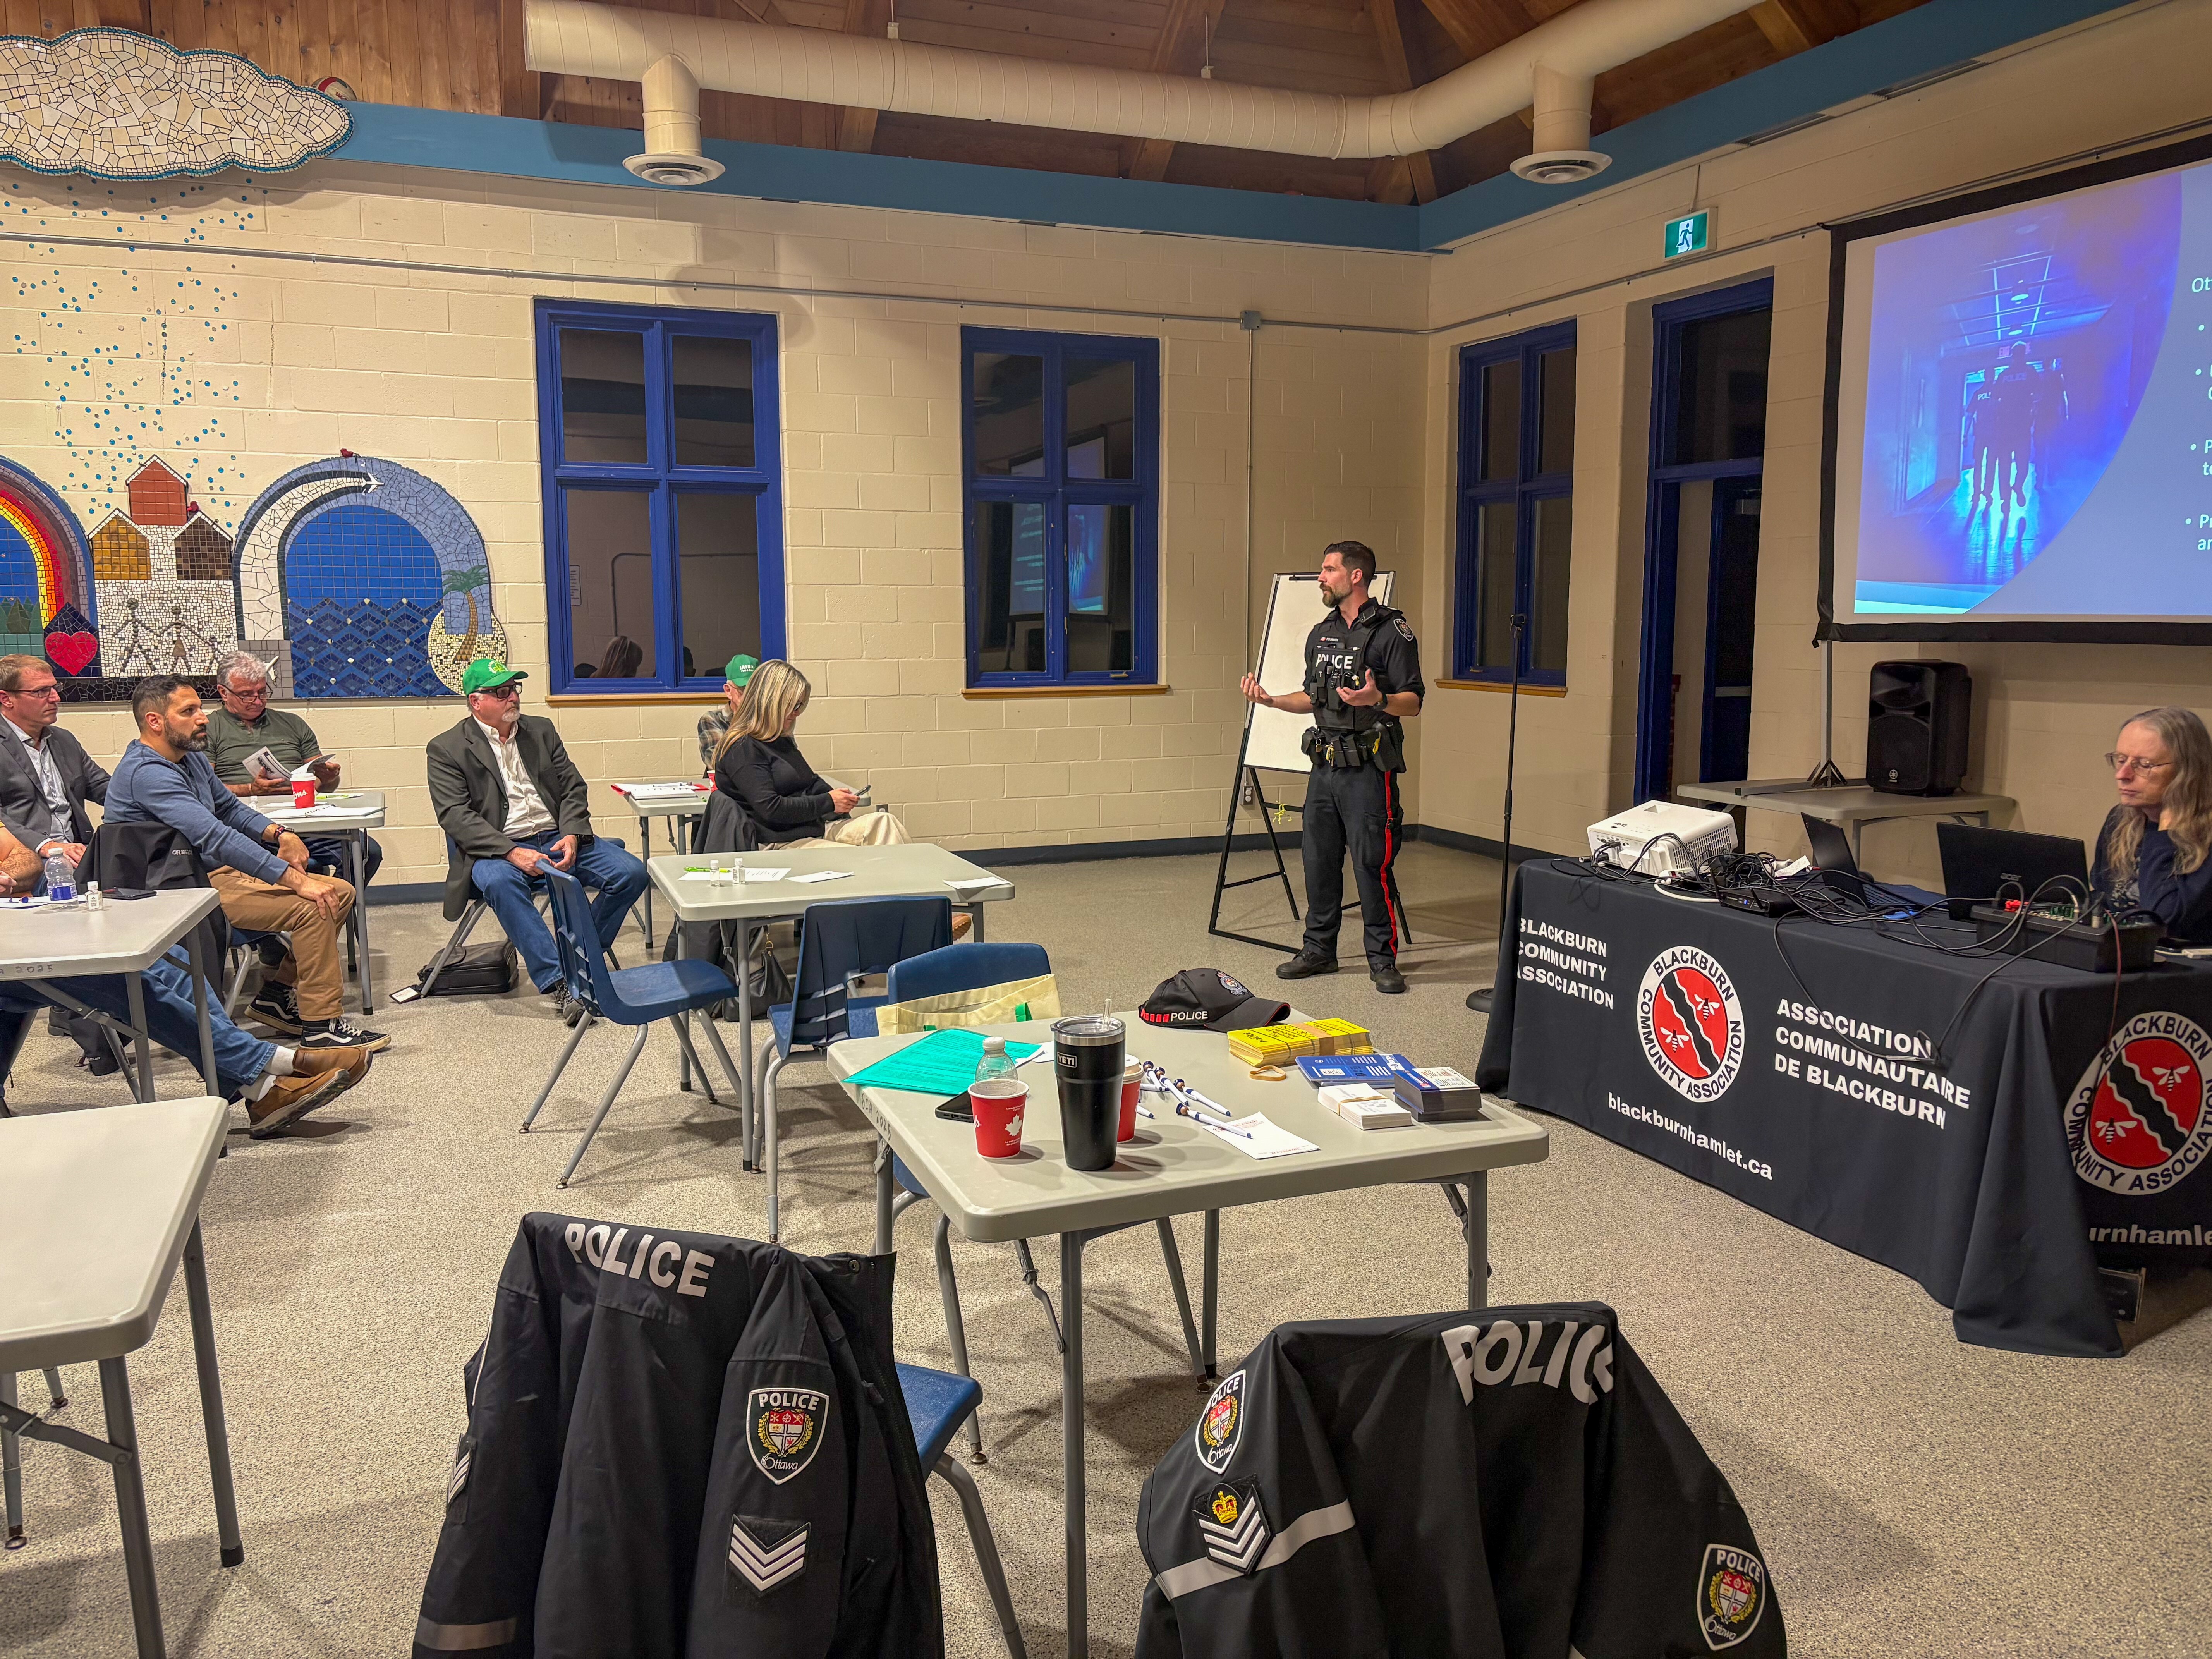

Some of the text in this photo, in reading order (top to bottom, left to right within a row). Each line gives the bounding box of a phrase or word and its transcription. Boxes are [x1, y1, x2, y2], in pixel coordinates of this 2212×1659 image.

[1653, 948, 1735, 1002] BLACKBURN
[1170, 1011, 1208, 1022] POLICE
[1640, 988, 1686, 1089] COMMUNITY
[1777, 998, 1932, 1059] ASSOCIATION
[2100, 1015, 2212, 1066] BLACKBURN
[1058, 1054, 1075, 1065] YETI
[1686, 1020, 1742, 1099] ASSOCIATION
[1775, 1026, 1971, 1109] COMMUNAUTAIRE
[1774, 1053, 1946, 1130] DE BLACKBURN
[1608, 1092, 1773, 1180] blackburnhamlet.ca
[564, 1223, 716, 1297] POLICE
[758, 1392, 820, 1411] POLICE
[761, 1452, 799, 1470] Ottawa
[1207, 1443, 1233, 1465] Ottawa
[1717, 1549, 1761, 1583] POLICE
